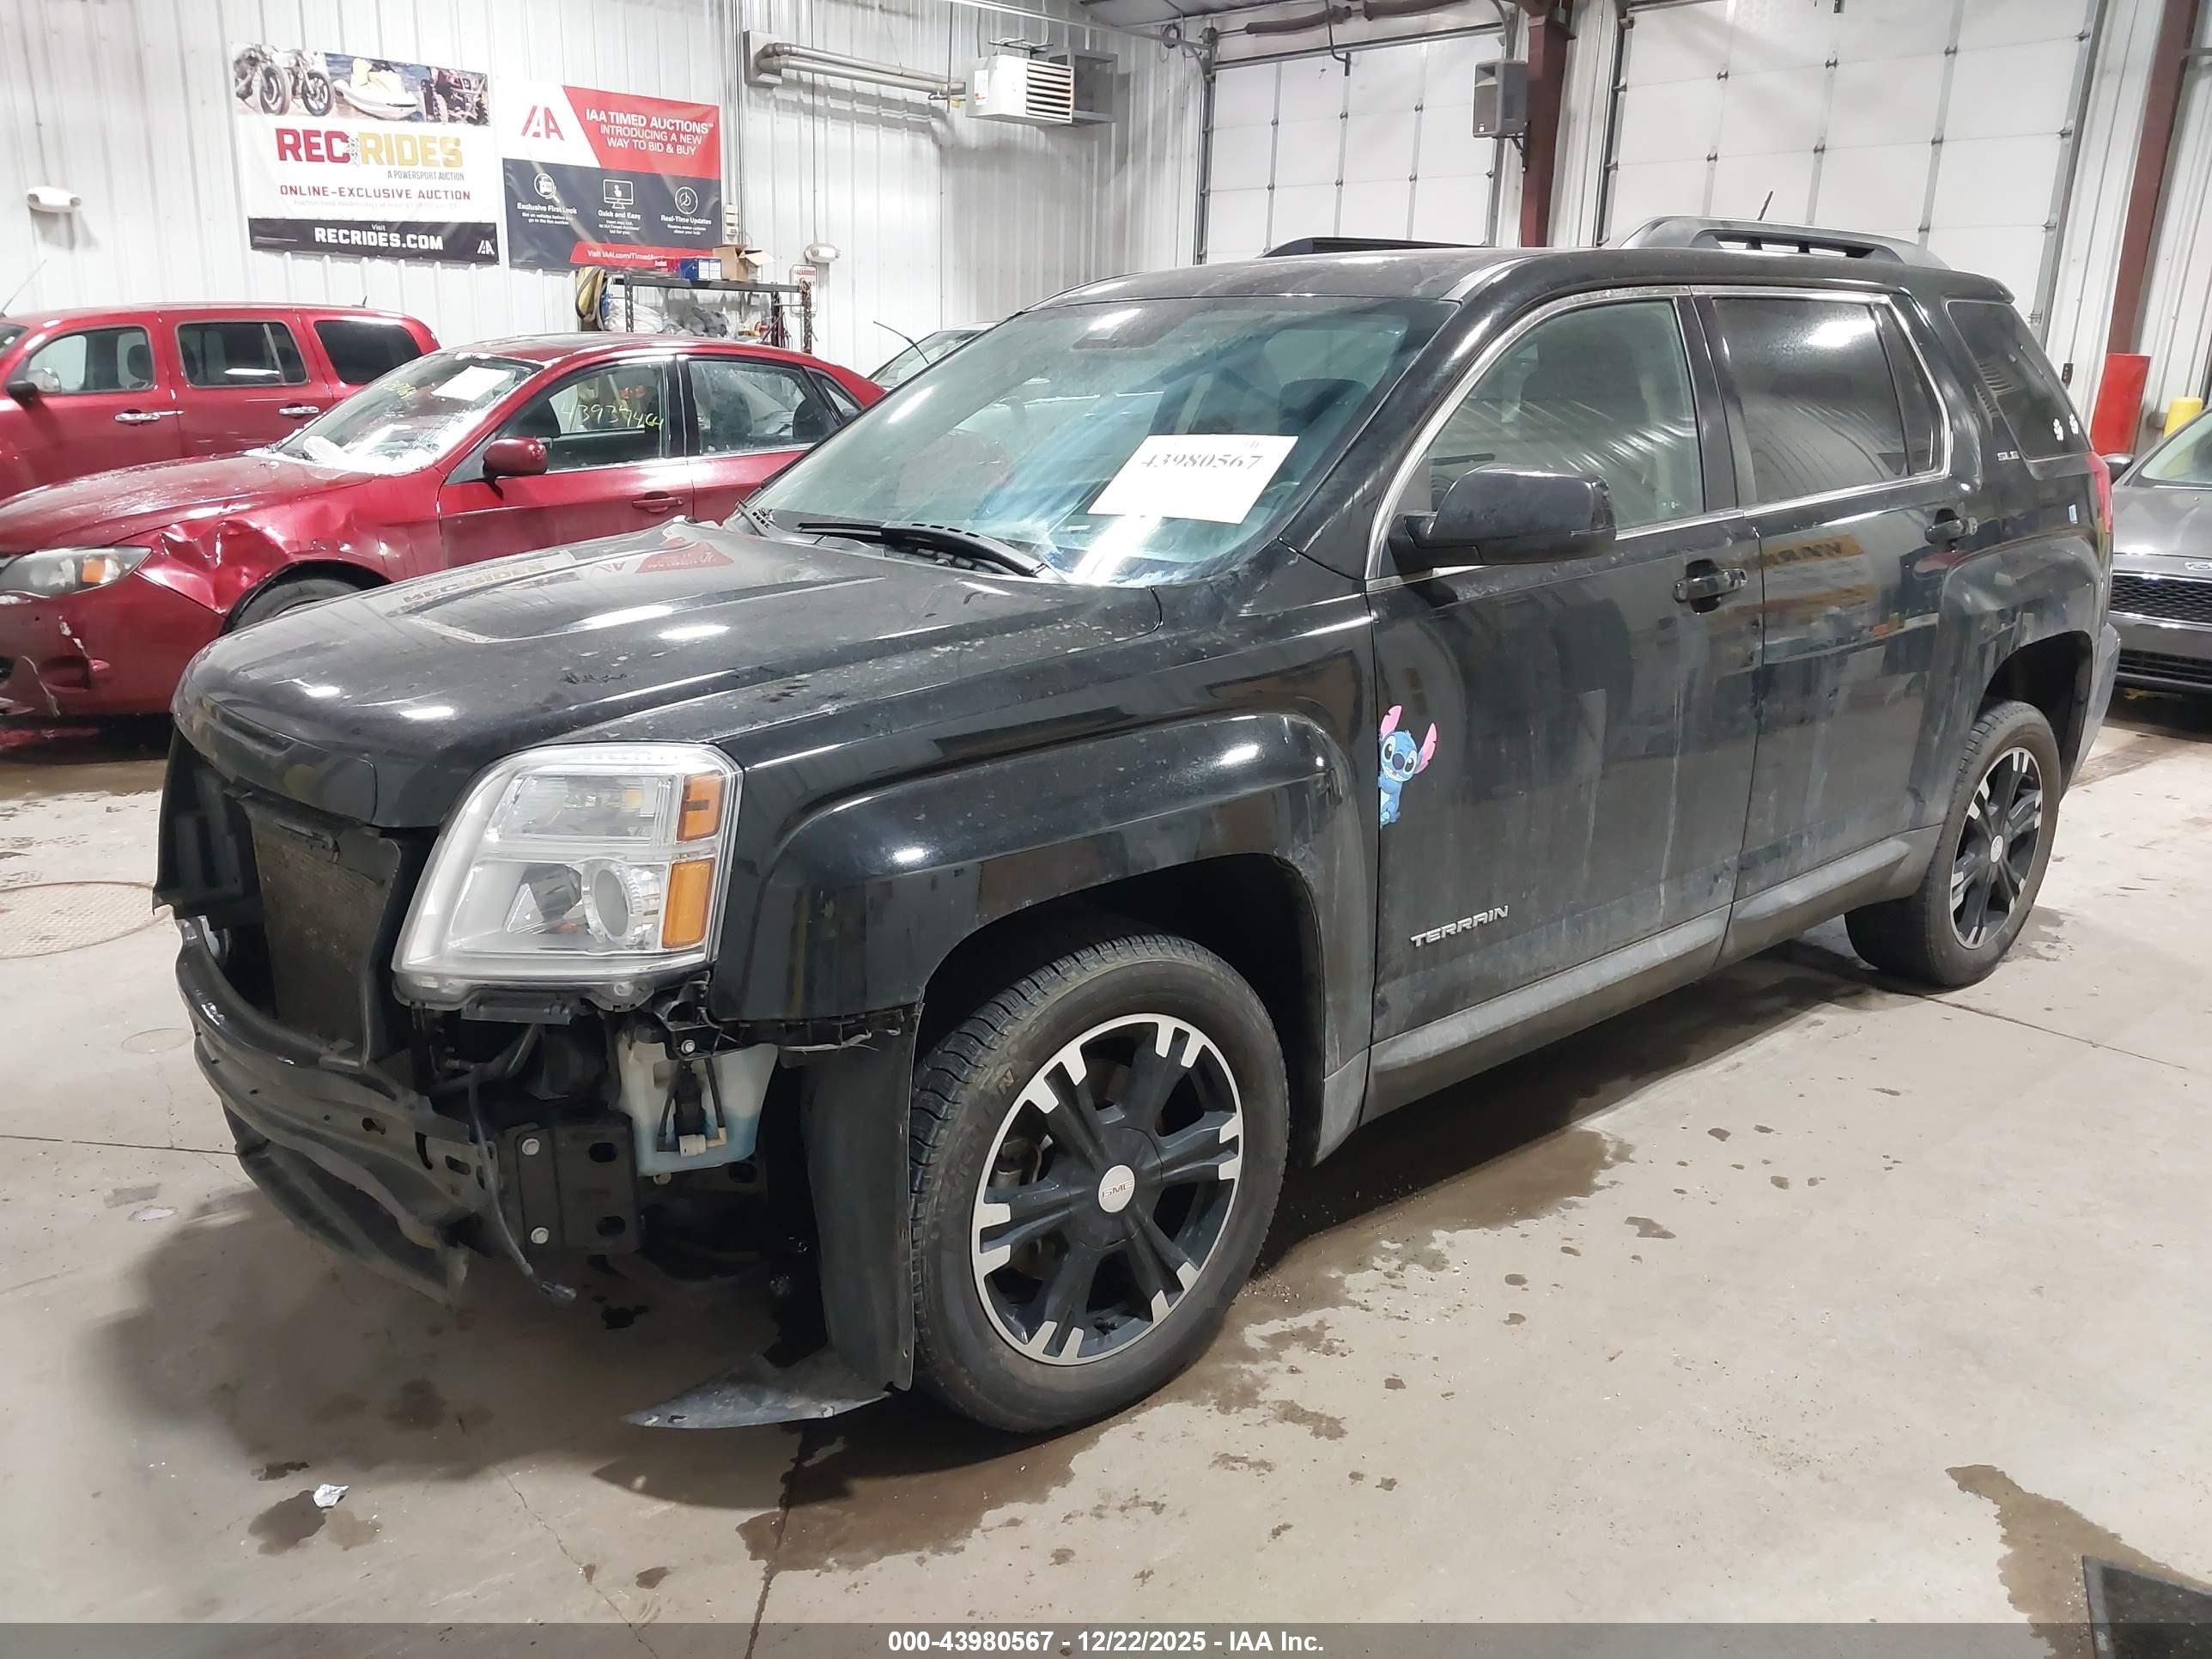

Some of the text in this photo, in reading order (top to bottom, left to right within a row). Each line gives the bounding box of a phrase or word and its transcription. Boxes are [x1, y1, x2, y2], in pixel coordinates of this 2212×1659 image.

[586, 108, 607, 123] IAA
[608, 112, 647, 127] TIMED
[600, 125, 702, 145] INTRODUCING A NEW
[275, 128, 464, 167] REC RIDES
[607, 137, 696, 155] WAY TO BID & BUY
[387, 170, 465, 181] A POWERSPORT AUCTION
[280, 185, 471, 200] ONLINE-EXCLUSIVE AUCTION
[517, 202, 547, 211] Exclusive
[660, 215, 712, 225] Real-Time Updates
[314, 227, 444, 250] RECRIDES.COM
[1140, 453, 1265, 470] 43980567
[1410, 905, 1509, 947] TERRAIN
